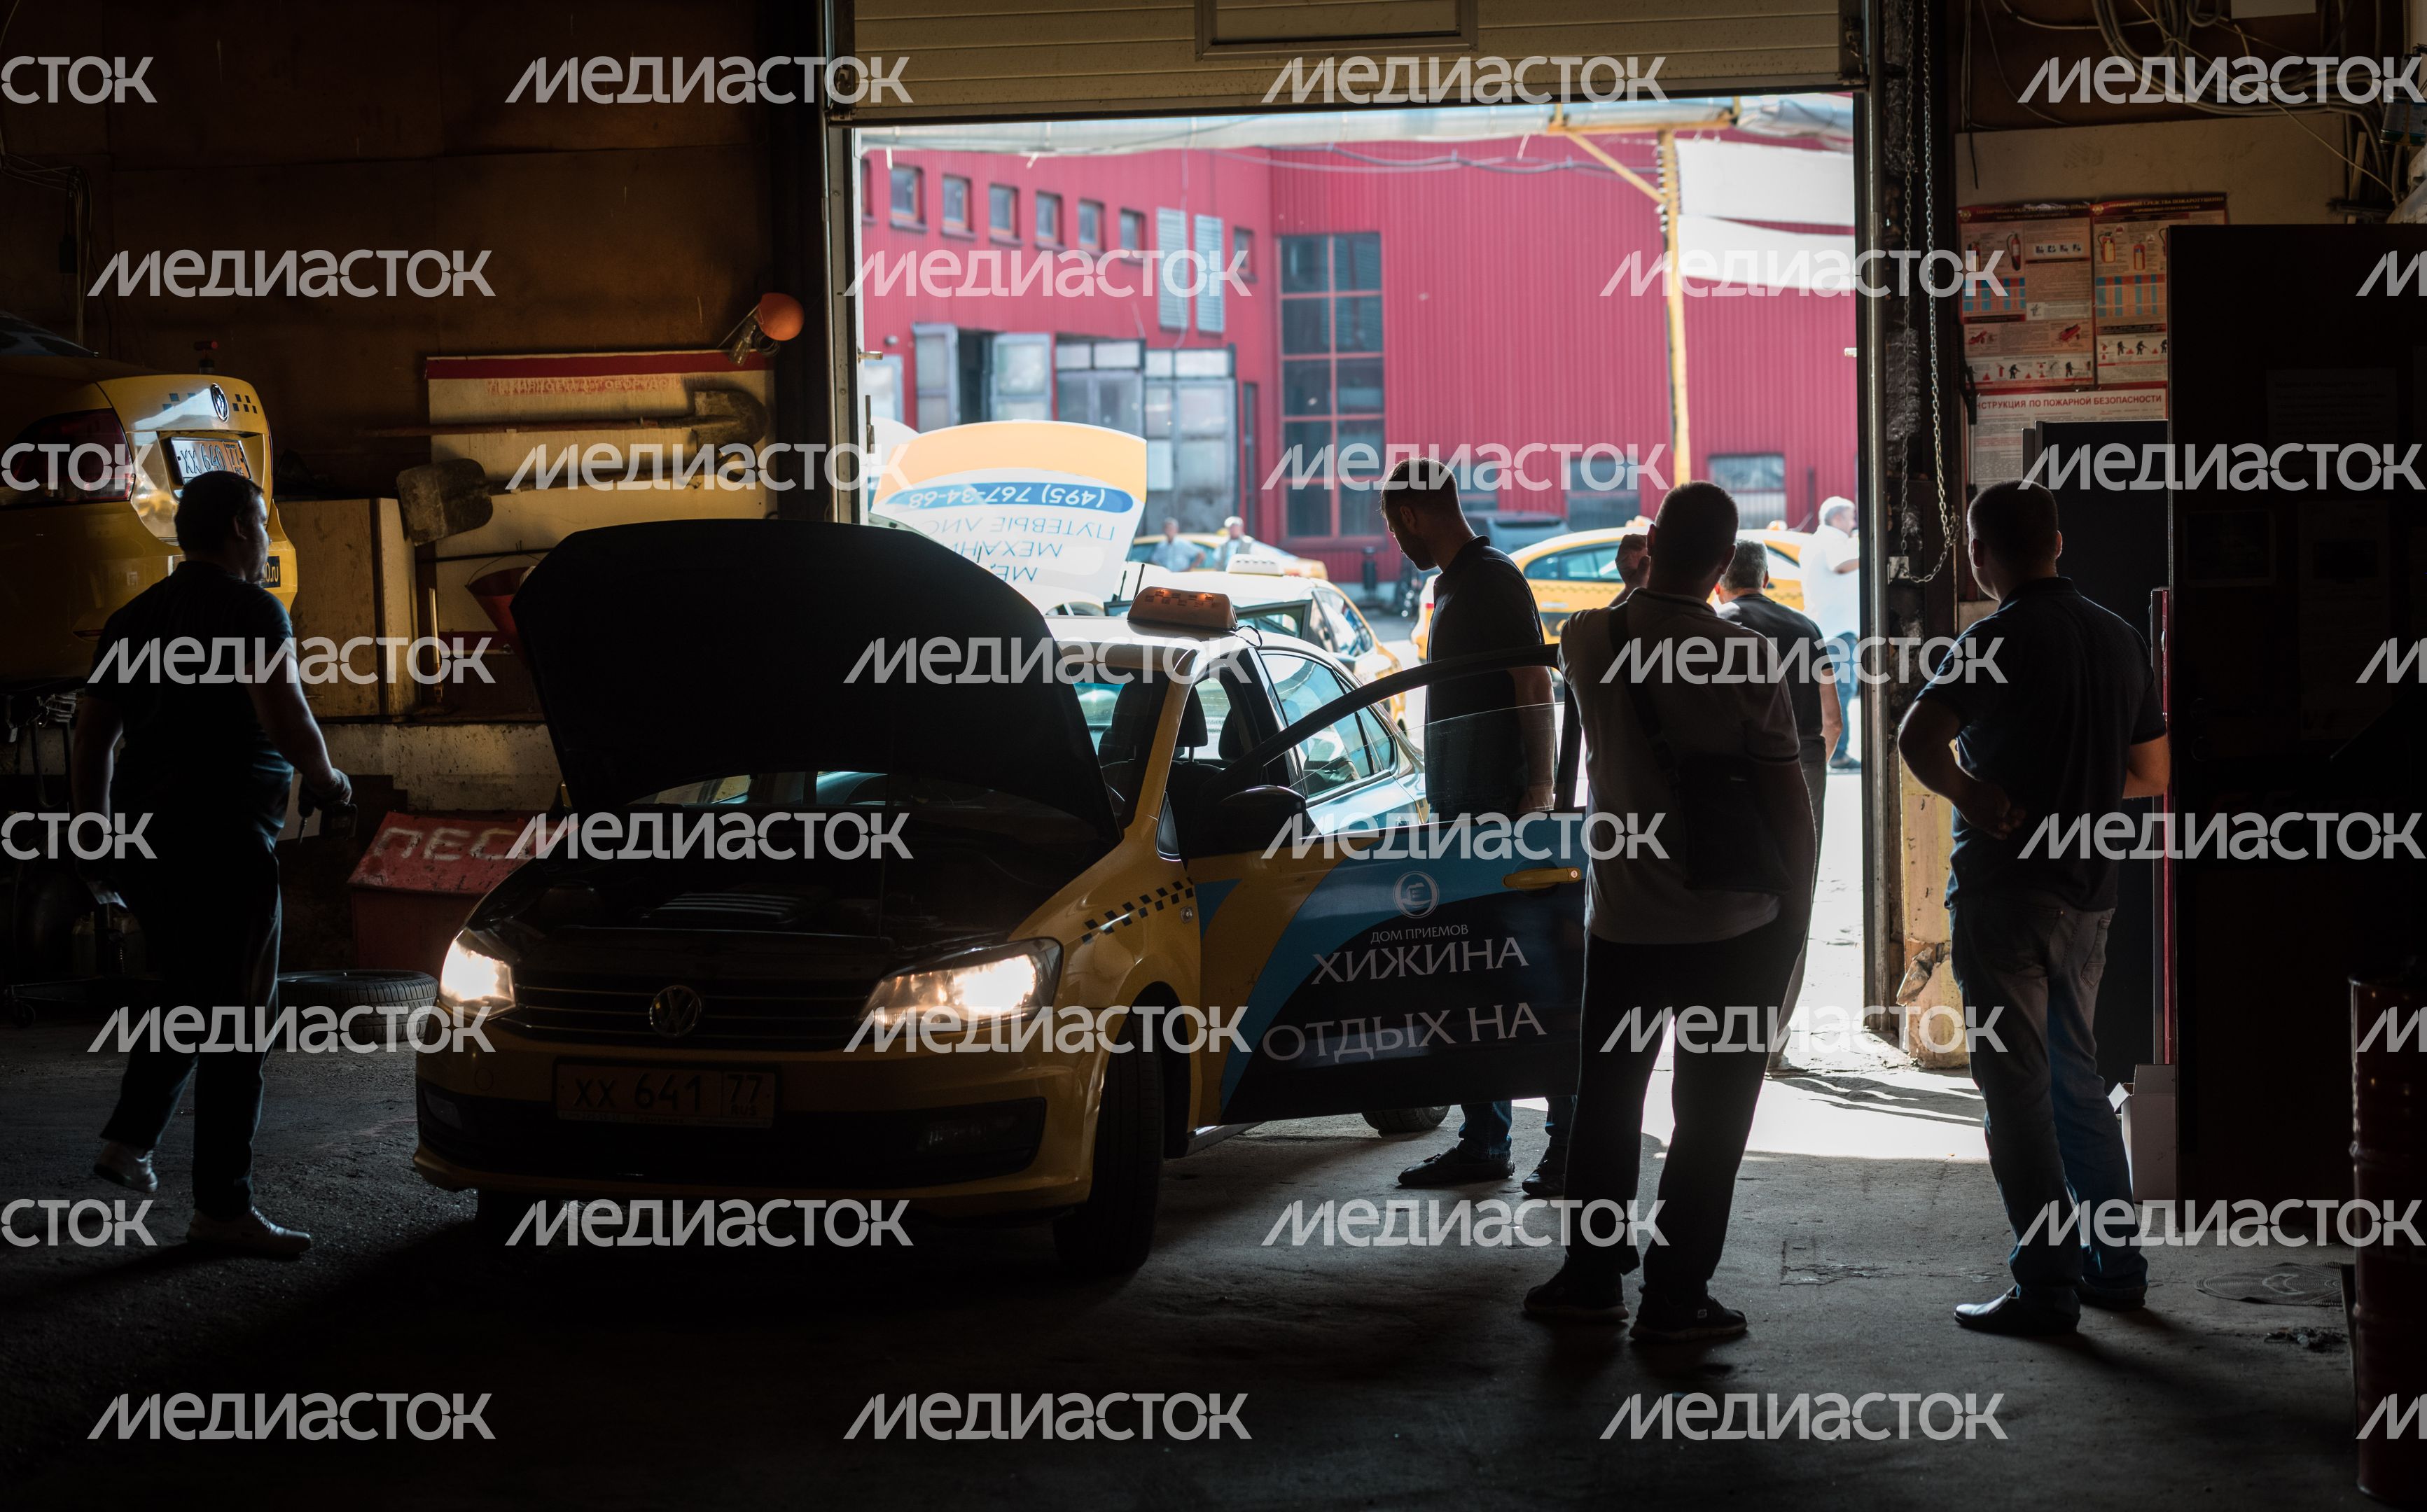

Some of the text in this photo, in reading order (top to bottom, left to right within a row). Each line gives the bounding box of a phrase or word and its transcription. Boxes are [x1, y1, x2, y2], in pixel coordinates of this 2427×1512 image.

[1976, 395, 2162, 410] НСТРУКЦИЯ ПО ПОЖАРНОЙ БЕЗОПАСНОСТИ
[200, 444, 227, 472] 640
[908, 484, 1105, 510] (495) 767-34-68
[989, 517, 1115, 542] ПУТЕВЫЕ
[1370, 923, 1469, 945] ДОМ ПРИЕМОВ
[1311, 937, 1530, 985] ХИЖИНА
[1262, 1002, 1548, 1063] ОТДЫХ НА
[634, 1073, 701, 1112] 641
[727, 1074, 763, 1103] 77
[730, 1104, 757, 1116] RUS
